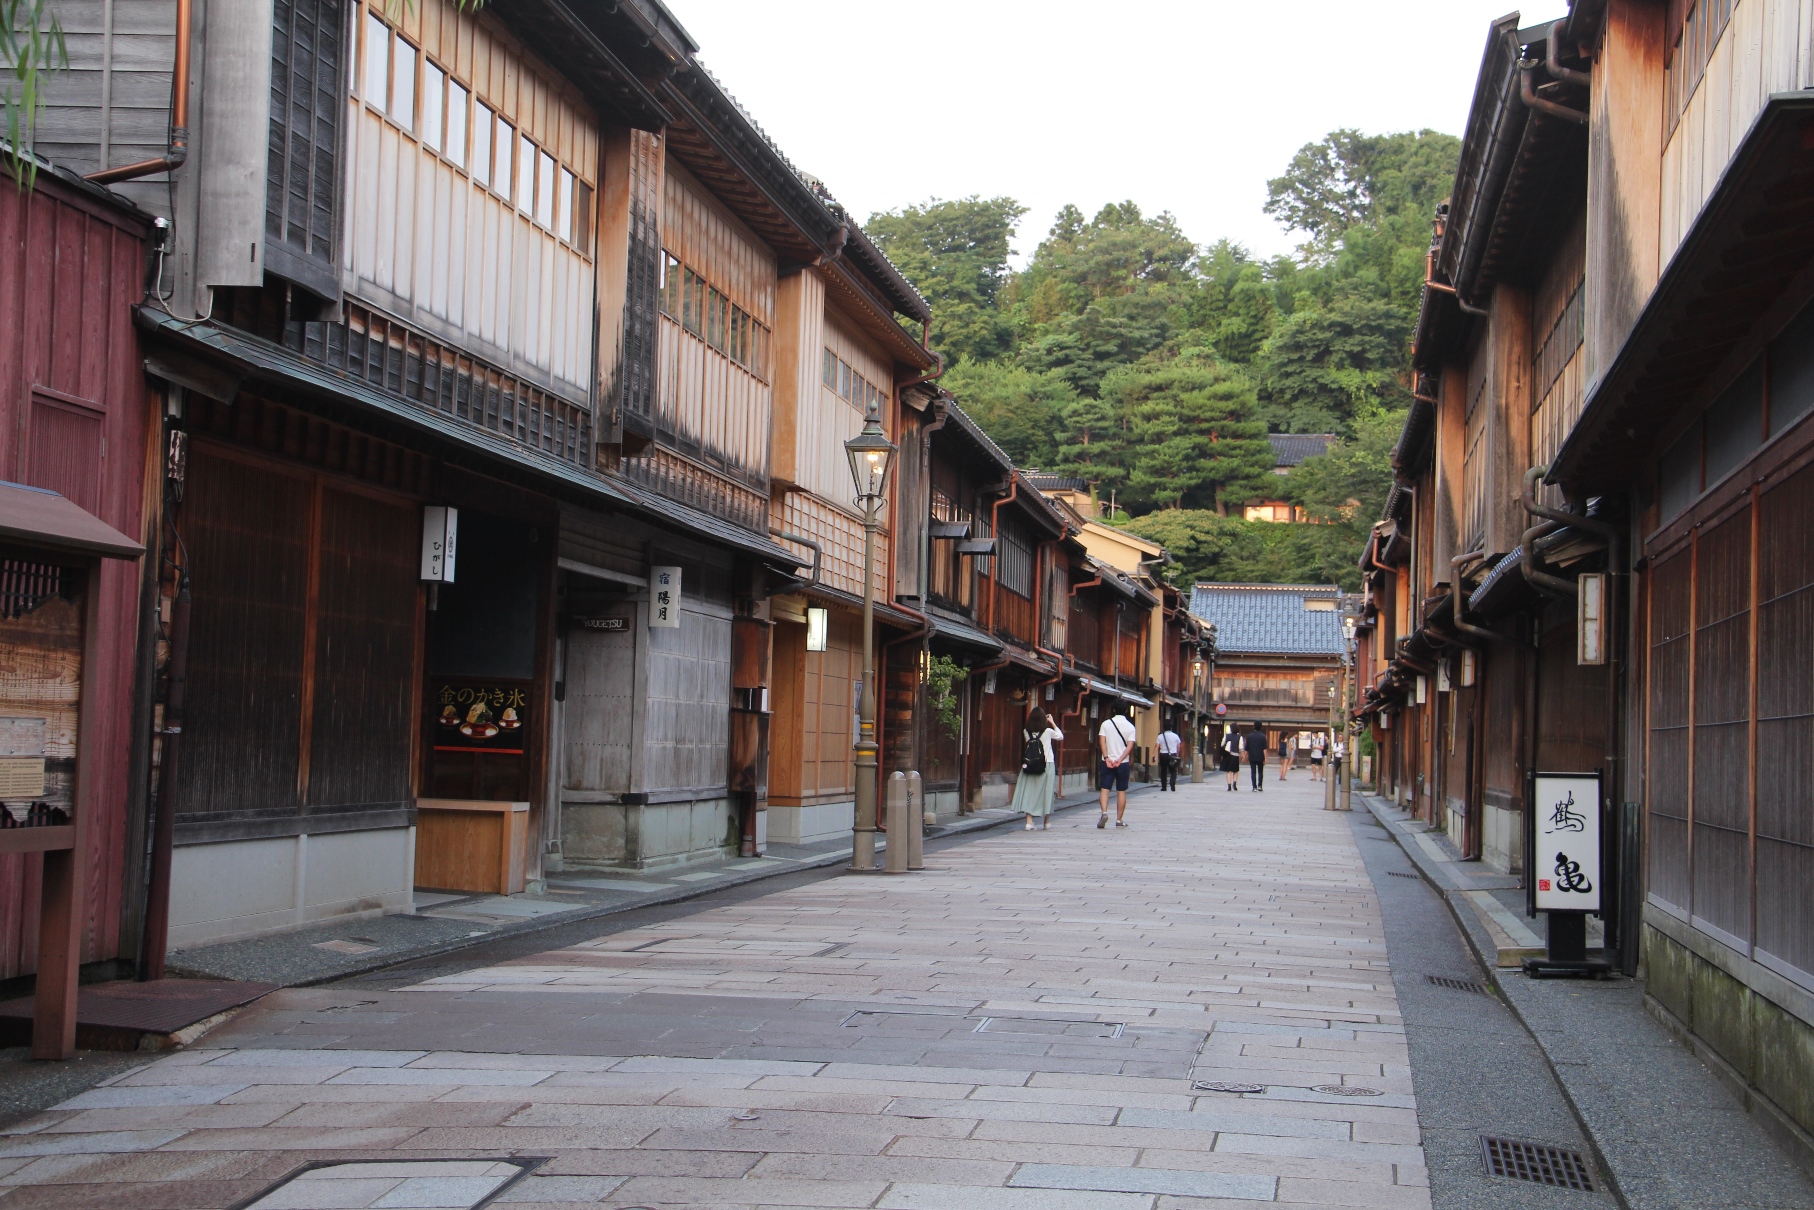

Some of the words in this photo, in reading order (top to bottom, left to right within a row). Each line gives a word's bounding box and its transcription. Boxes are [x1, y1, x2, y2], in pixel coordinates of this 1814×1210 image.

[432, 541, 442, 575] ひがし
[437, 685, 526, 708] 金のかき氷
